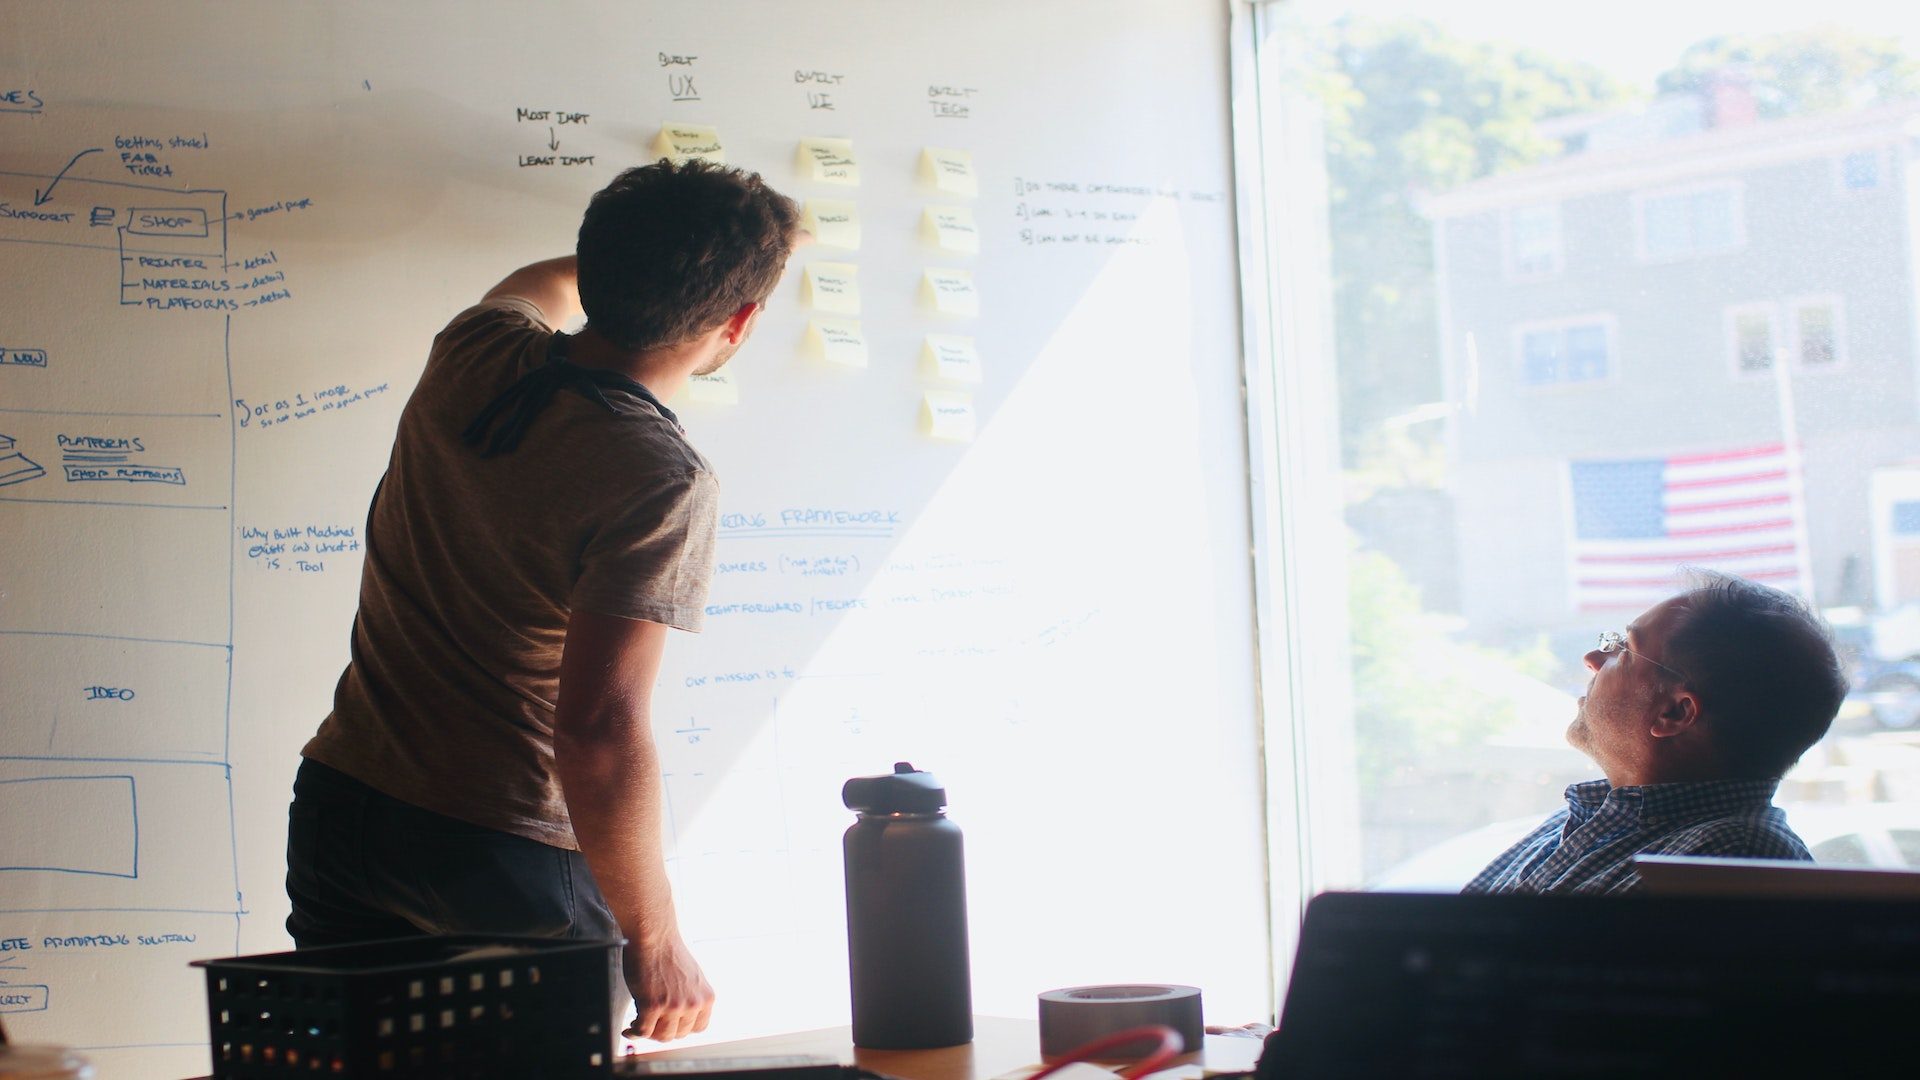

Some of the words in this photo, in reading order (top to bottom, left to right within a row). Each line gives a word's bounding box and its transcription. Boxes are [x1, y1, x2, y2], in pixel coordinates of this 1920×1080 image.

[659, 52, 697, 67] BUILT
[669, 74, 697, 97] UX
[794, 70, 844, 85] BUILT
[928, 85, 978, 98] BUILT
[807, 92, 836, 110] UI
[929, 101, 969, 115] TECH
[516, 107, 551, 122] MOST
[556, 111, 590, 125] IMPT
[519, 155, 556, 167] LEAST
[140, 215, 192, 229] SHOP
[139, 256, 208, 270] PRINTER
[244, 251, 278, 270] detail
[142, 278, 231, 291] MATERIALS
[252, 271, 285, 288] detail
[146, 298, 239, 311] PLATFORMS
[260, 289, 292, 305] detail
[14, 352, 43, 363] NOW
[255, 404, 269, 416] or
[275, 400, 290, 411] as
[314, 384, 350, 401] image
[58, 434, 145, 451] PLATFORMS
[71, 470, 109, 480] SHOP
[117, 469, 180, 482] PLATFORMS
[780, 508, 900, 527] FRAMEWORK
[242, 526, 269, 542] Why
[306, 525, 355, 538] Machines
[266, 558, 280, 570] is
[296, 560, 324, 572] Tool
[686, 675, 707, 688] Our
[715, 672, 760, 684] mission
[766, 669, 777, 680] is
[782, 664, 796, 679] to
[84, 686, 135, 701] IDEO
[0, 937, 32, 951] ETE
